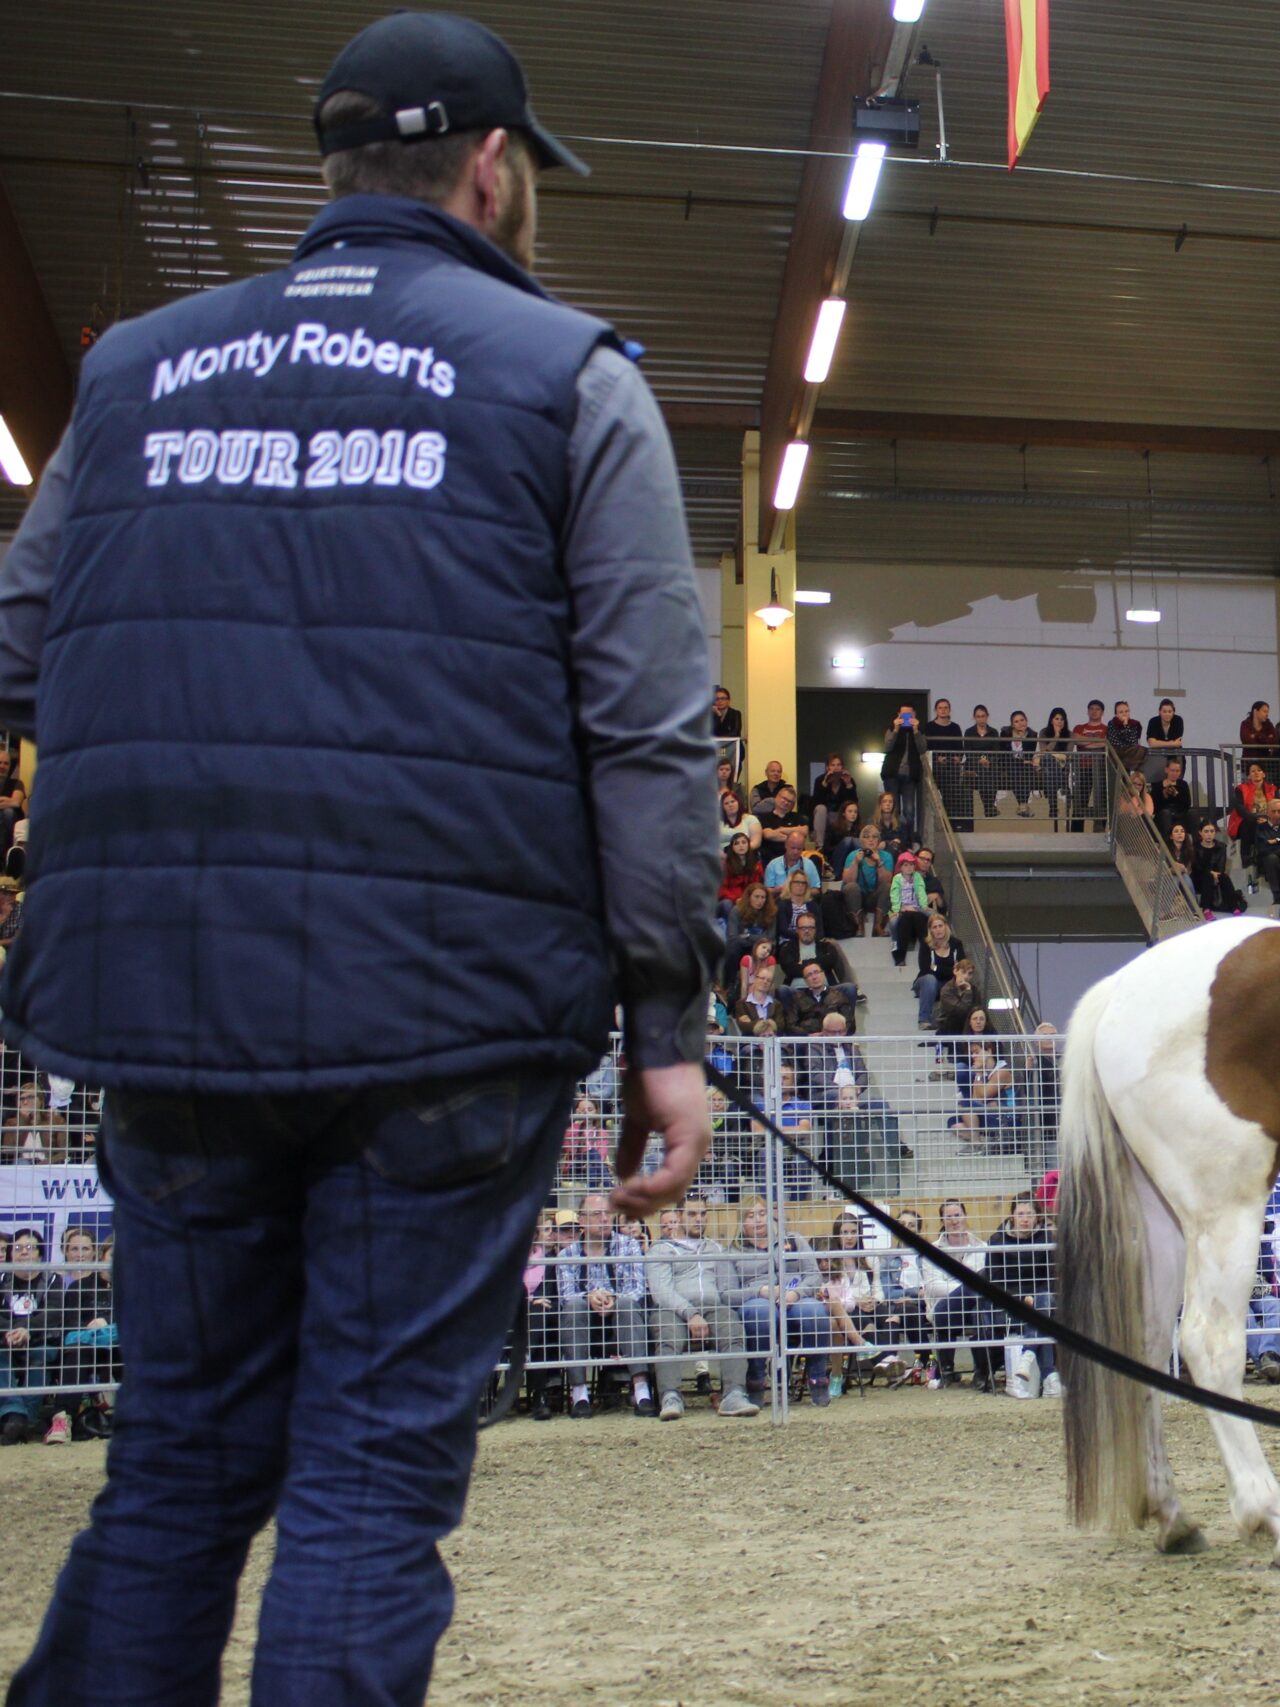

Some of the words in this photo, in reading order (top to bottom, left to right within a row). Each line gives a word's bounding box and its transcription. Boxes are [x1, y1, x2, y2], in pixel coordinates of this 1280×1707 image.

[152, 330, 290, 401] Monty
[289, 322, 456, 398] Roberts
[144, 429, 300, 488] TOUR
[304, 429, 447, 490] 2016
